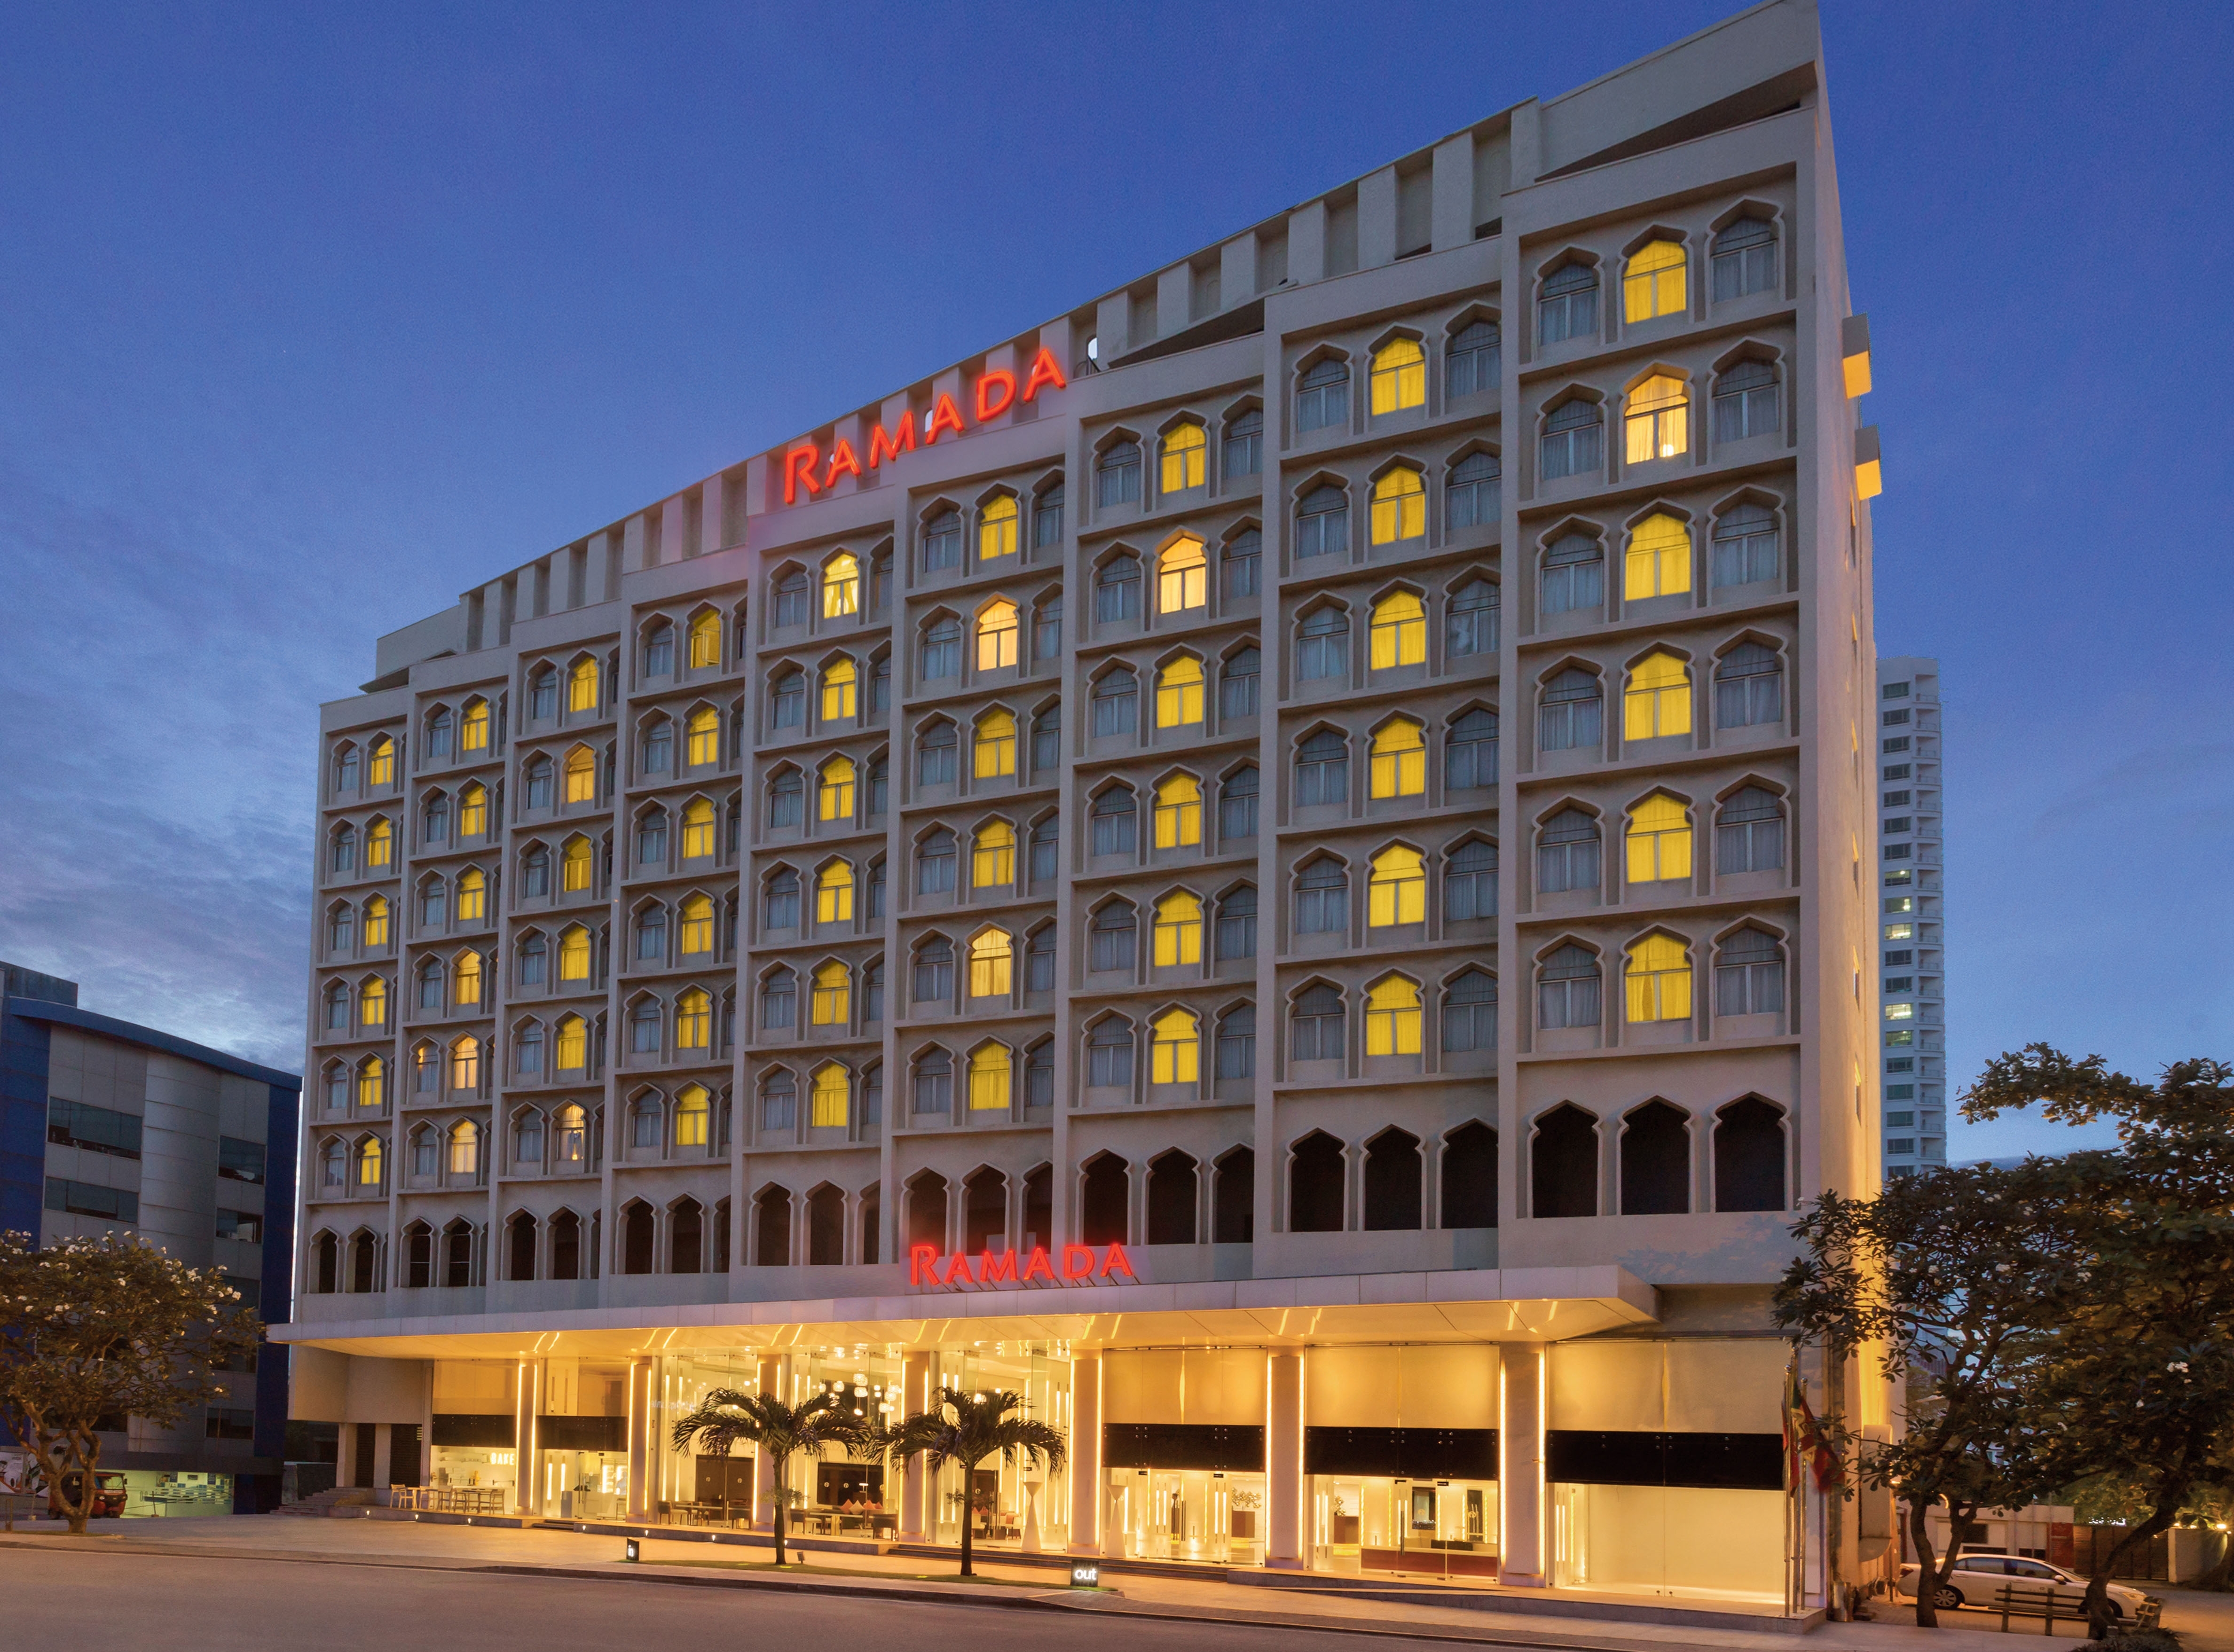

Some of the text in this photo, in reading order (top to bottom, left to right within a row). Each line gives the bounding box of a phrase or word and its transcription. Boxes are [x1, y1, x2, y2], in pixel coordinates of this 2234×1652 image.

[784, 348, 1066, 504] RAMADA
[910, 1243, 1133, 1285] RAMADA
[628, 1545, 634, 1557] in
[1075, 1568, 1097, 1580] out
